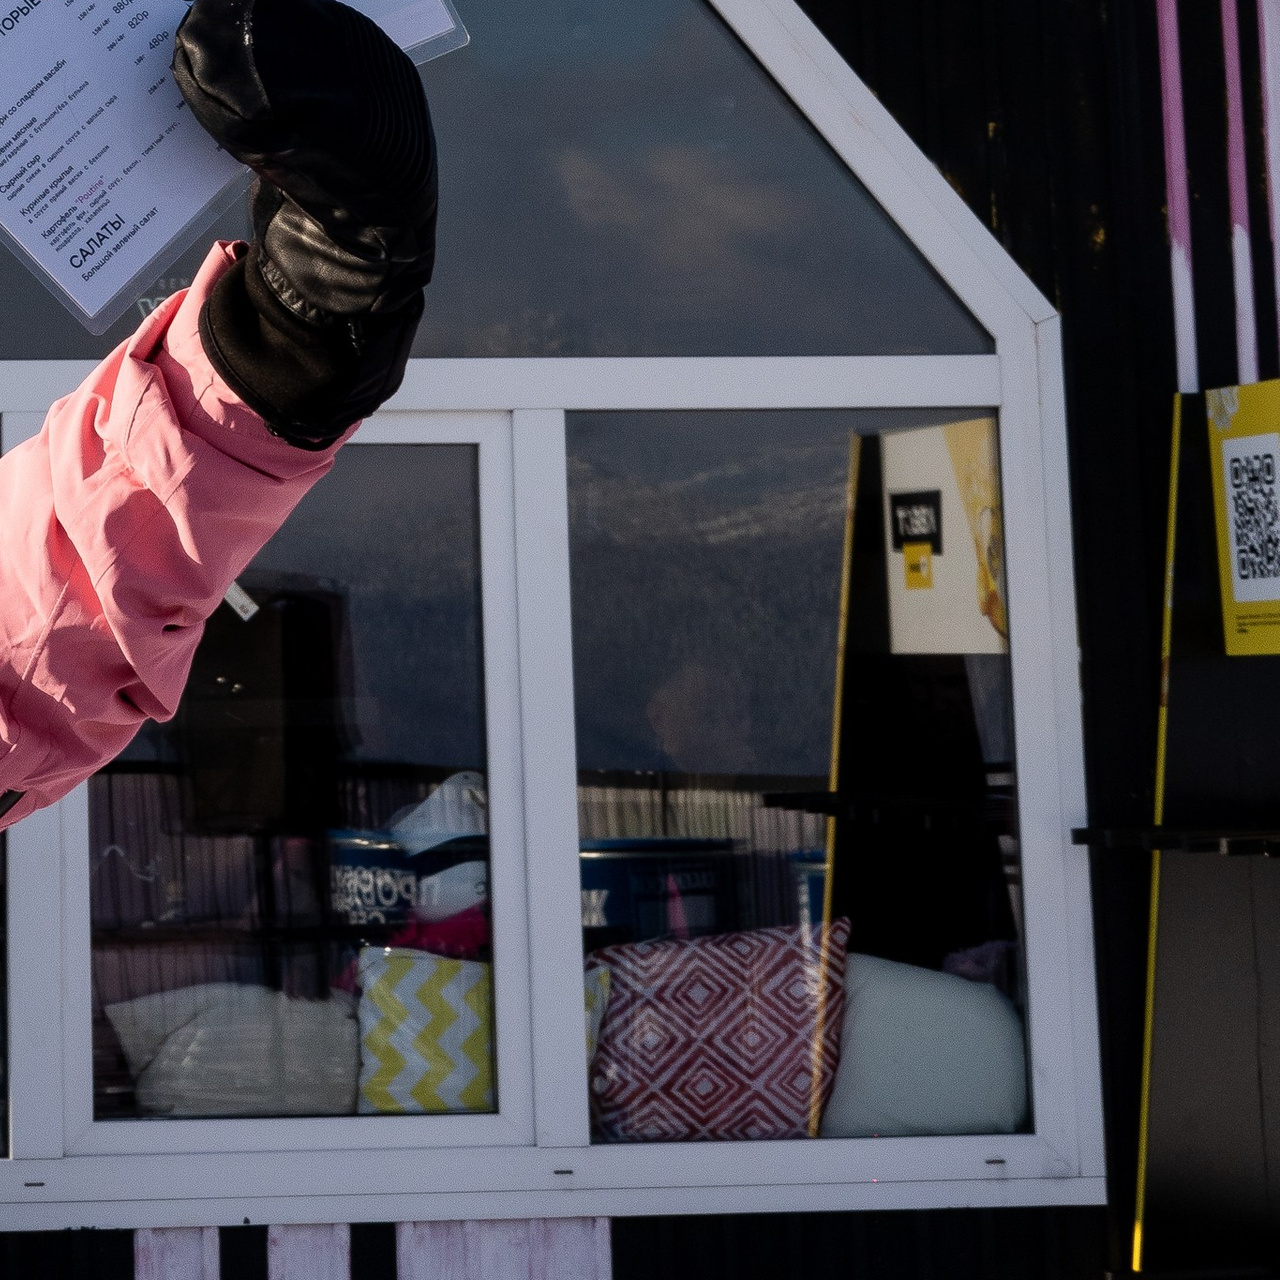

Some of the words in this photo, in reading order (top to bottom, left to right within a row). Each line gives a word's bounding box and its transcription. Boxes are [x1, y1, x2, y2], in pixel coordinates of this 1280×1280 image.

[127, 10, 149, 30] 820р
[148, 30, 170, 50] 480р
[7, 105, 18, 116] со
[15, 79, 45, 108] сладким
[42, 58, 67, 82] васаби
[11, 116, 38, 142] мясные
[26, 154, 41, 169] сыр
[19, 188, 51, 217] Куриные
[48, 165, 74, 190] крылья
[40, 205, 78, 240] Картофель
[73, 174, 108, 206] "Poutine"
[69, 213, 126, 269] САЛАТЫ
[81, 250, 114, 282] Большой
[111, 223, 141, 253] зеленый
[138, 206, 158, 227] салат
